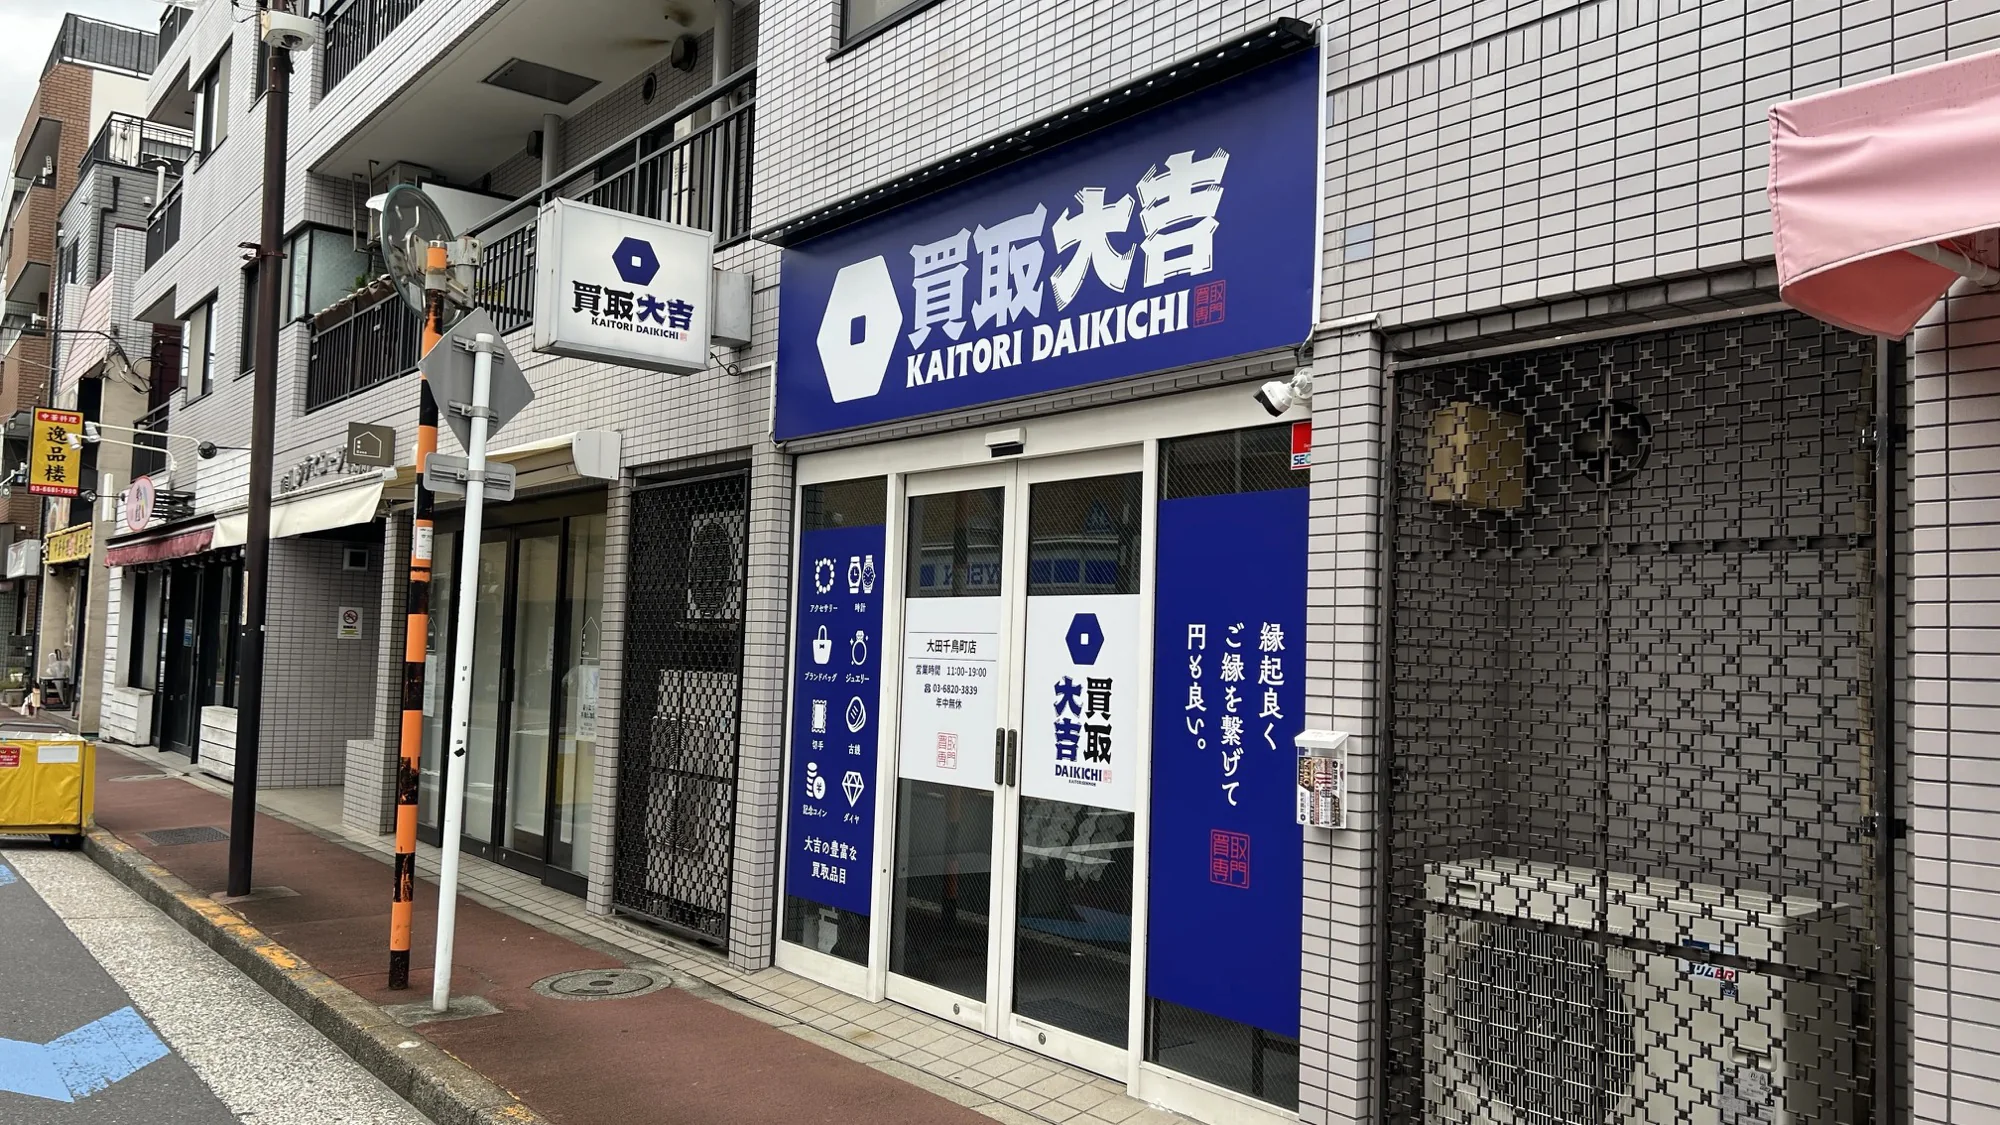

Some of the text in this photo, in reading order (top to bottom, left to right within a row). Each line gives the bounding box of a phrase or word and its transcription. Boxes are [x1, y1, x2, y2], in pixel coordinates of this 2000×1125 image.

[909, 147, 1230, 350] 買取大吉
[572, 280, 694, 331] 買取大吉
[591, 317, 633, 331] KAITORI
[636, 324, 679, 340] DAIKICHI
[906, 289, 1190, 388] KAITORI DAIKICHI
[44, 426, 68, 483] 逸品楼
[809, 604, 838, 612] アクセサリー
[854, 603, 866, 612] 時計
[926, 639, 977, 654] 大田千鳥町店
[804, 671, 838, 682] ブランドバッグ
[845, 673, 870, 684] ジュエリー
[916, 664, 987, 678] 営業時間 11:00-19:00
[933, 684, 978, 695] 03-6820-3839
[1185, 624, 1207, 750] 円も良い。
[1258, 621, 1286, 751] 縁起良く
[936, 697, 962, 710] 年中無休
[1053, 675, 1084, 762] 大吉
[1083, 676, 1113, 765] 買取
[1220, 622, 1246, 806] ご縁を繋げて
[812, 739, 824, 751] 切手
[848, 743, 861, 756] 古銭
[1055, 764, 1102, 781] DAIKICHI
[802, 804, 828, 817] 記念コイン
[843, 812, 860, 825] ダイヤ
[804, 835, 857, 861] 大吉の豊富な
[811, 861, 846, 884] 買取品目
